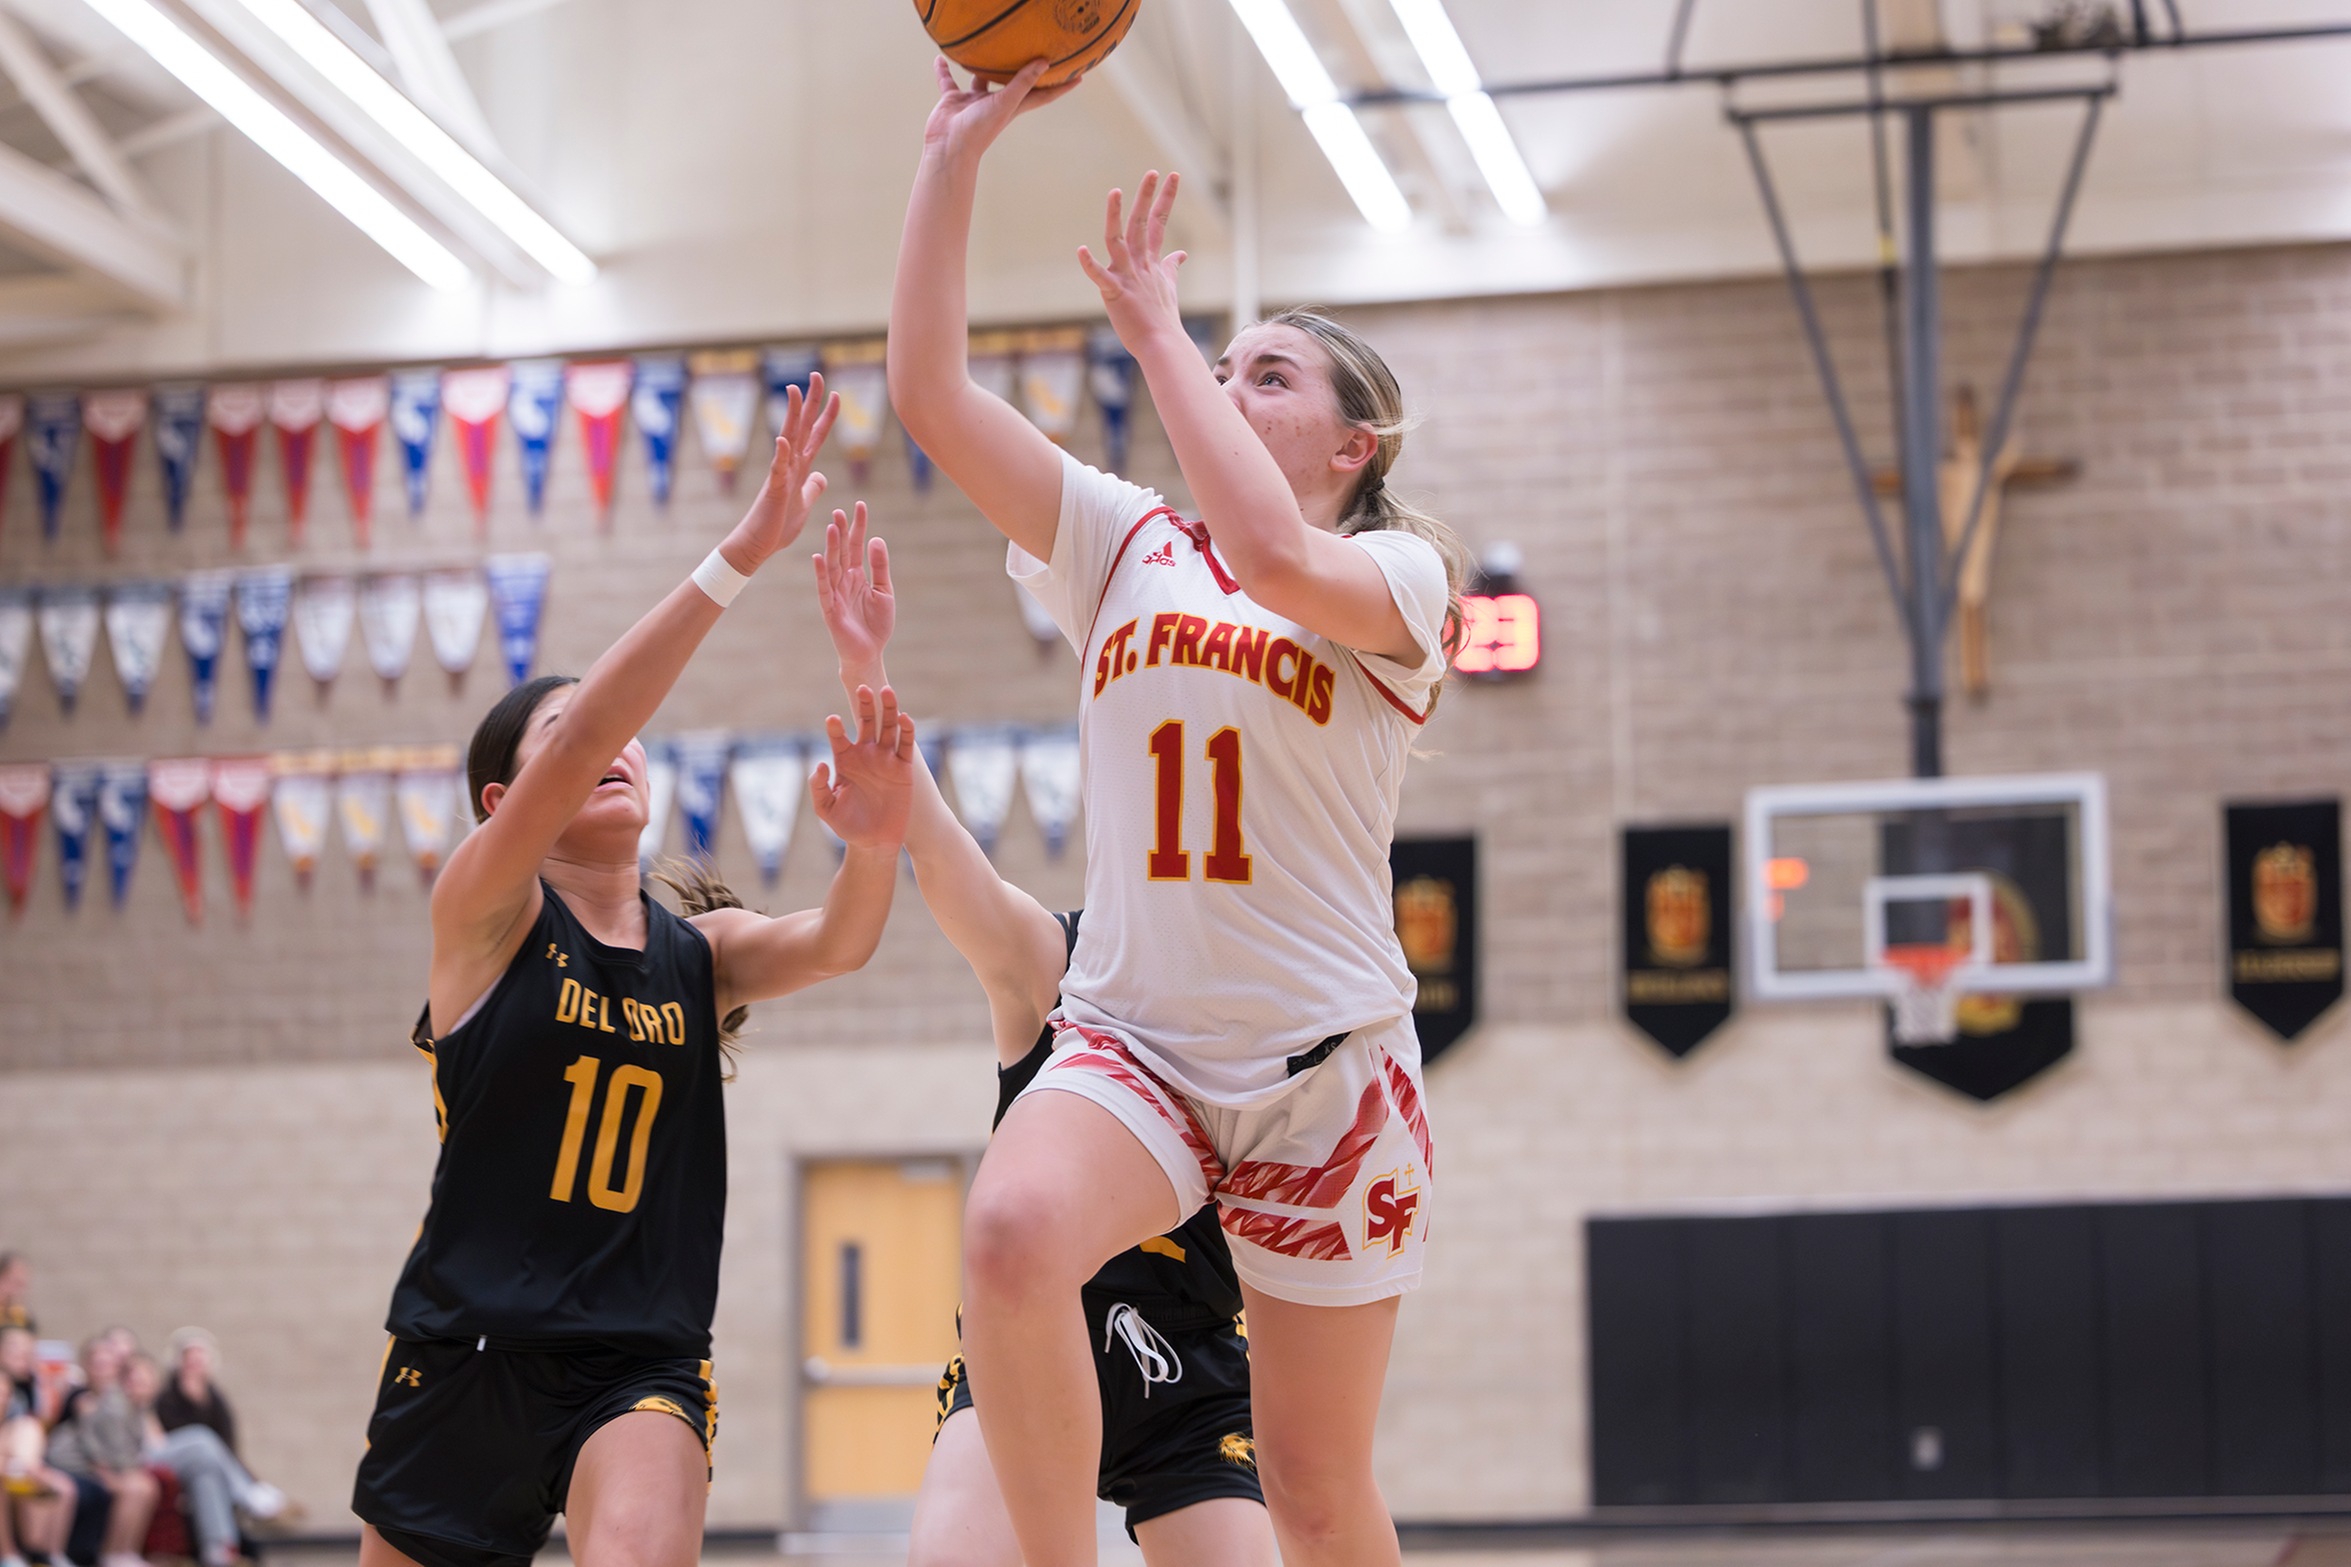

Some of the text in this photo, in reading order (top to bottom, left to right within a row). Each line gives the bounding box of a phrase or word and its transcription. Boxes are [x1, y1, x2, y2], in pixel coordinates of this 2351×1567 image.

[1093, 611, 1337, 727] ST. FRANCIS
[1147, 718, 1252, 885] 11
[555, 977, 686, 1046] DEL ORO
[549, 1054, 663, 1214] 10
[1362, 1167, 1421, 1259] SF
